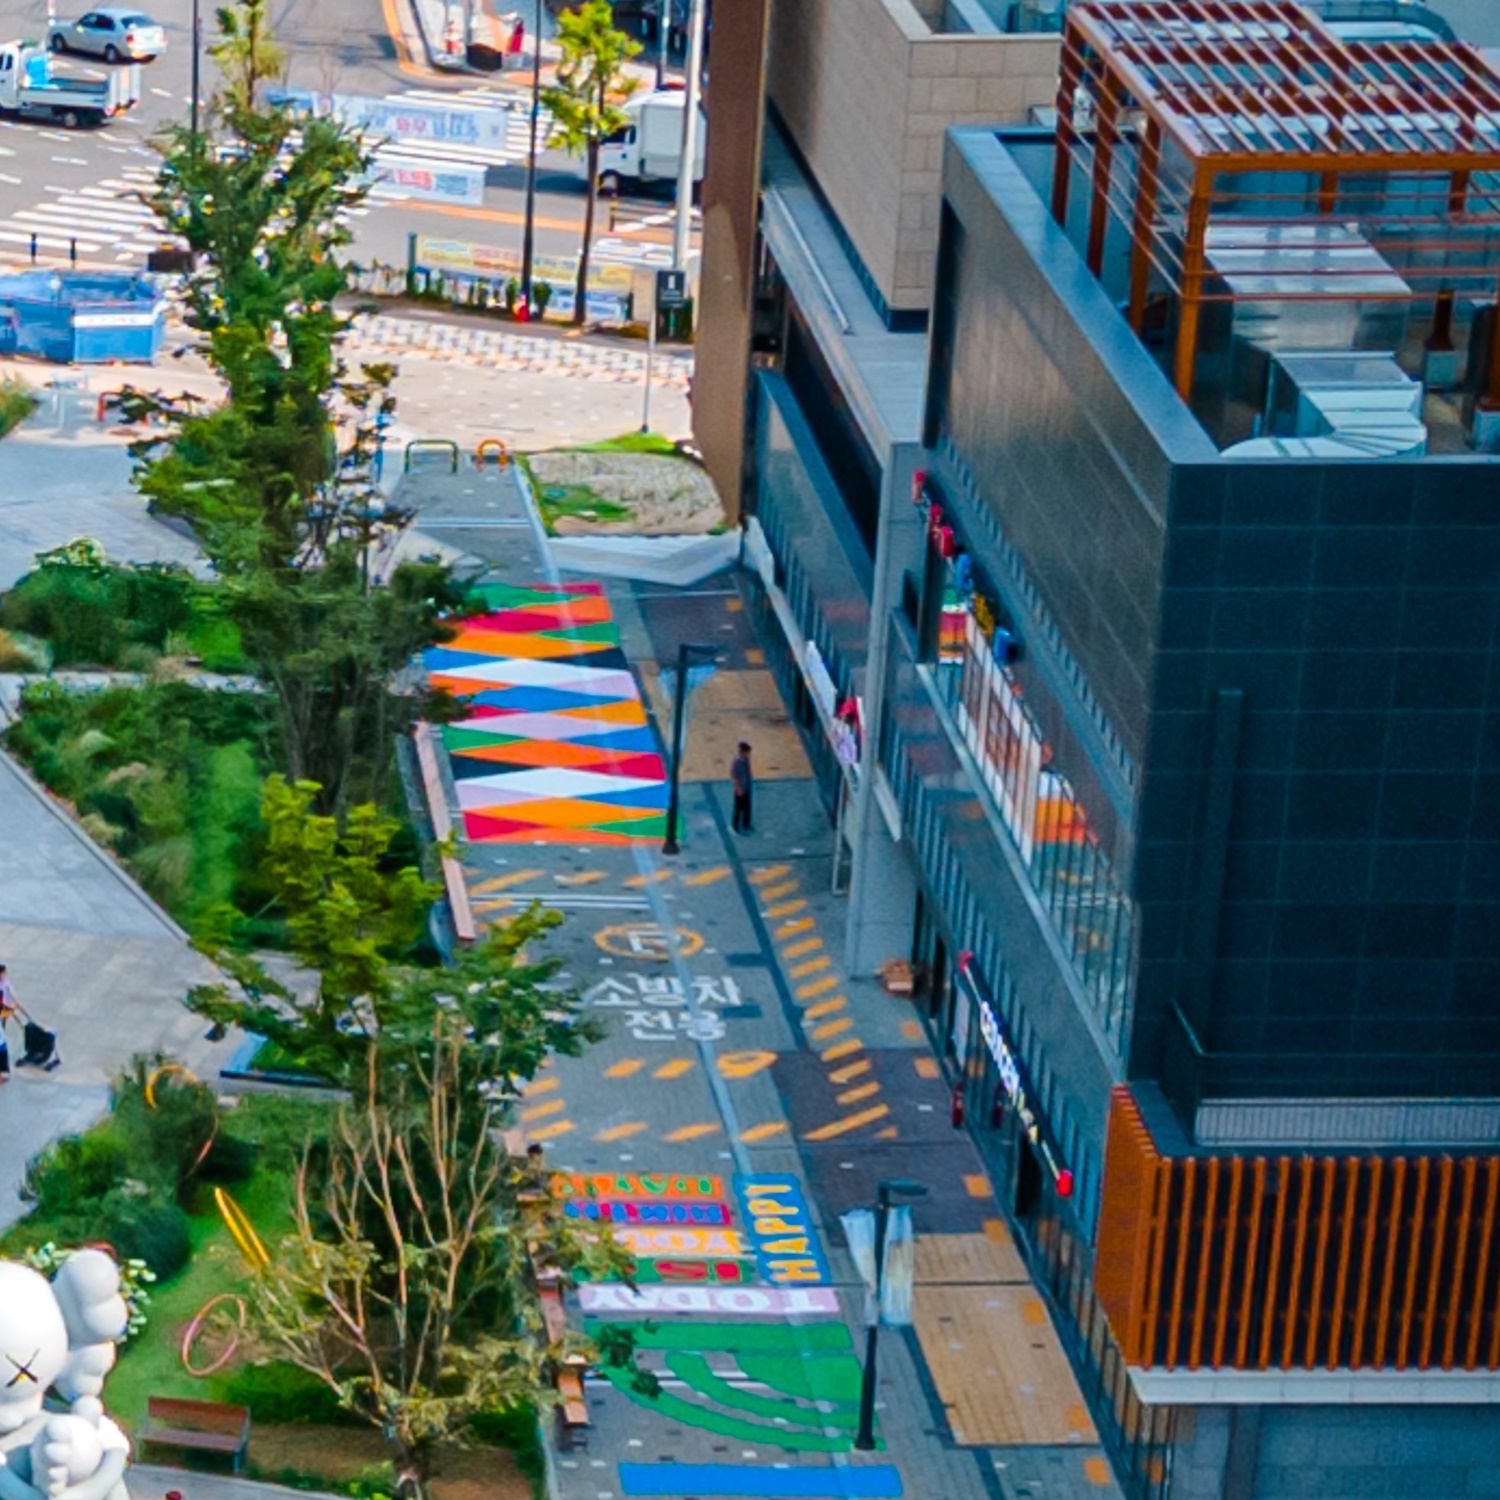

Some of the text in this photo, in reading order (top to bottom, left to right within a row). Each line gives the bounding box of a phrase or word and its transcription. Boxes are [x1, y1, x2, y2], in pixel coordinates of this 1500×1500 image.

[584, 974, 742, 1009] 소방차
[624, 1010, 727, 1042] 전용
[590, 1287, 826, 1312] TODAY
